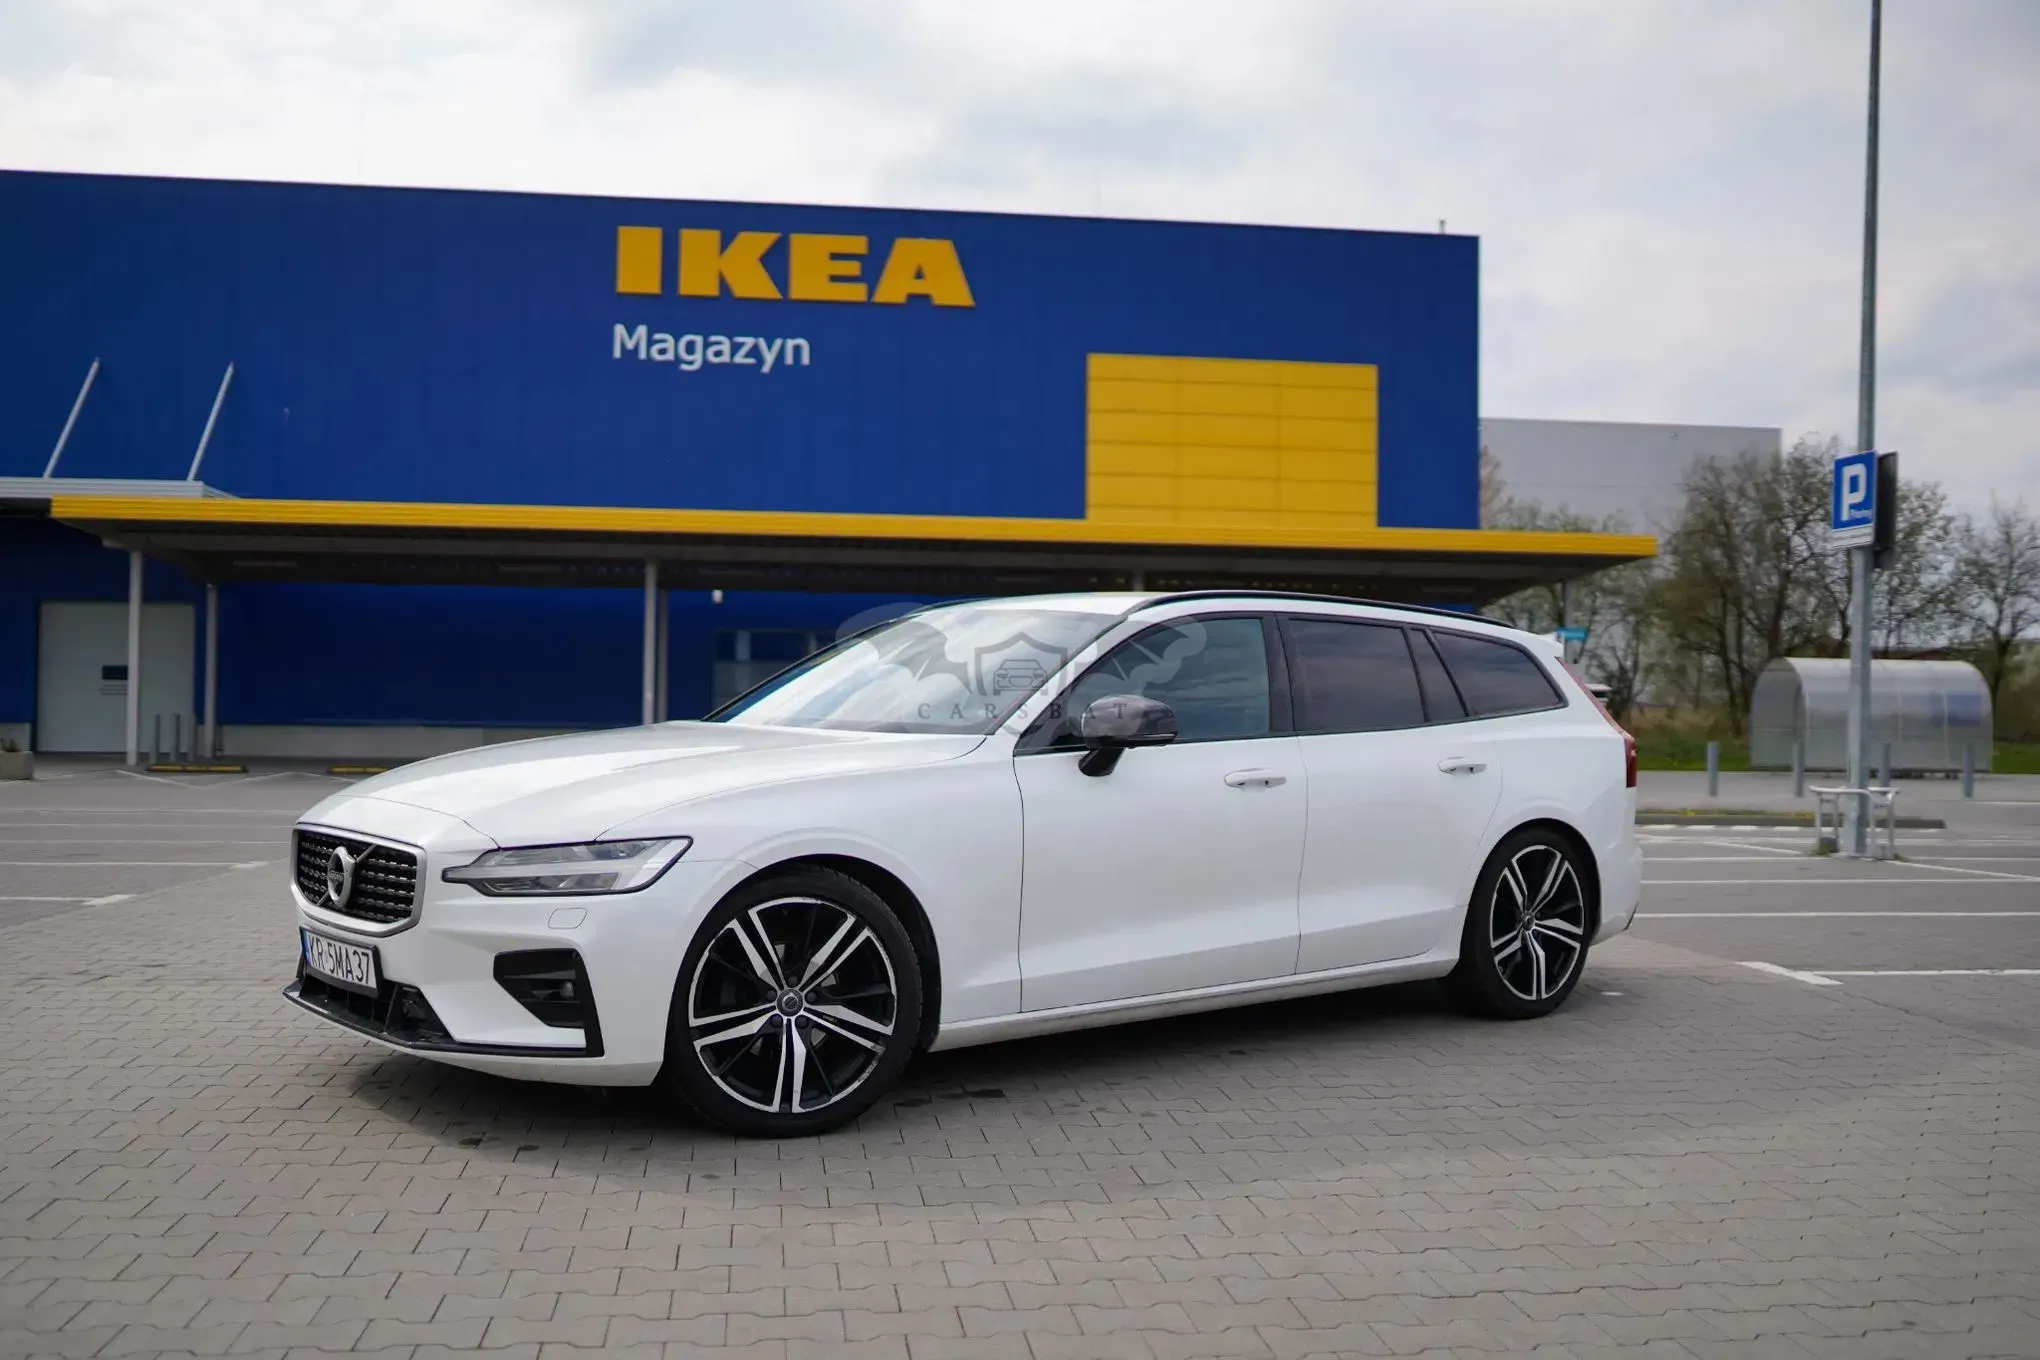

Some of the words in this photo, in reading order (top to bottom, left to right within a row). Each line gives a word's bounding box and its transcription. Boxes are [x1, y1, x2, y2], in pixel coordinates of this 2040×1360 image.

[616, 225, 976, 308] IKEA
[612, 323, 811, 374] Magazyn
[1841, 463, 1867, 521] P
[308, 934, 326, 971] KR
[327, 941, 370, 985] 5MA37
